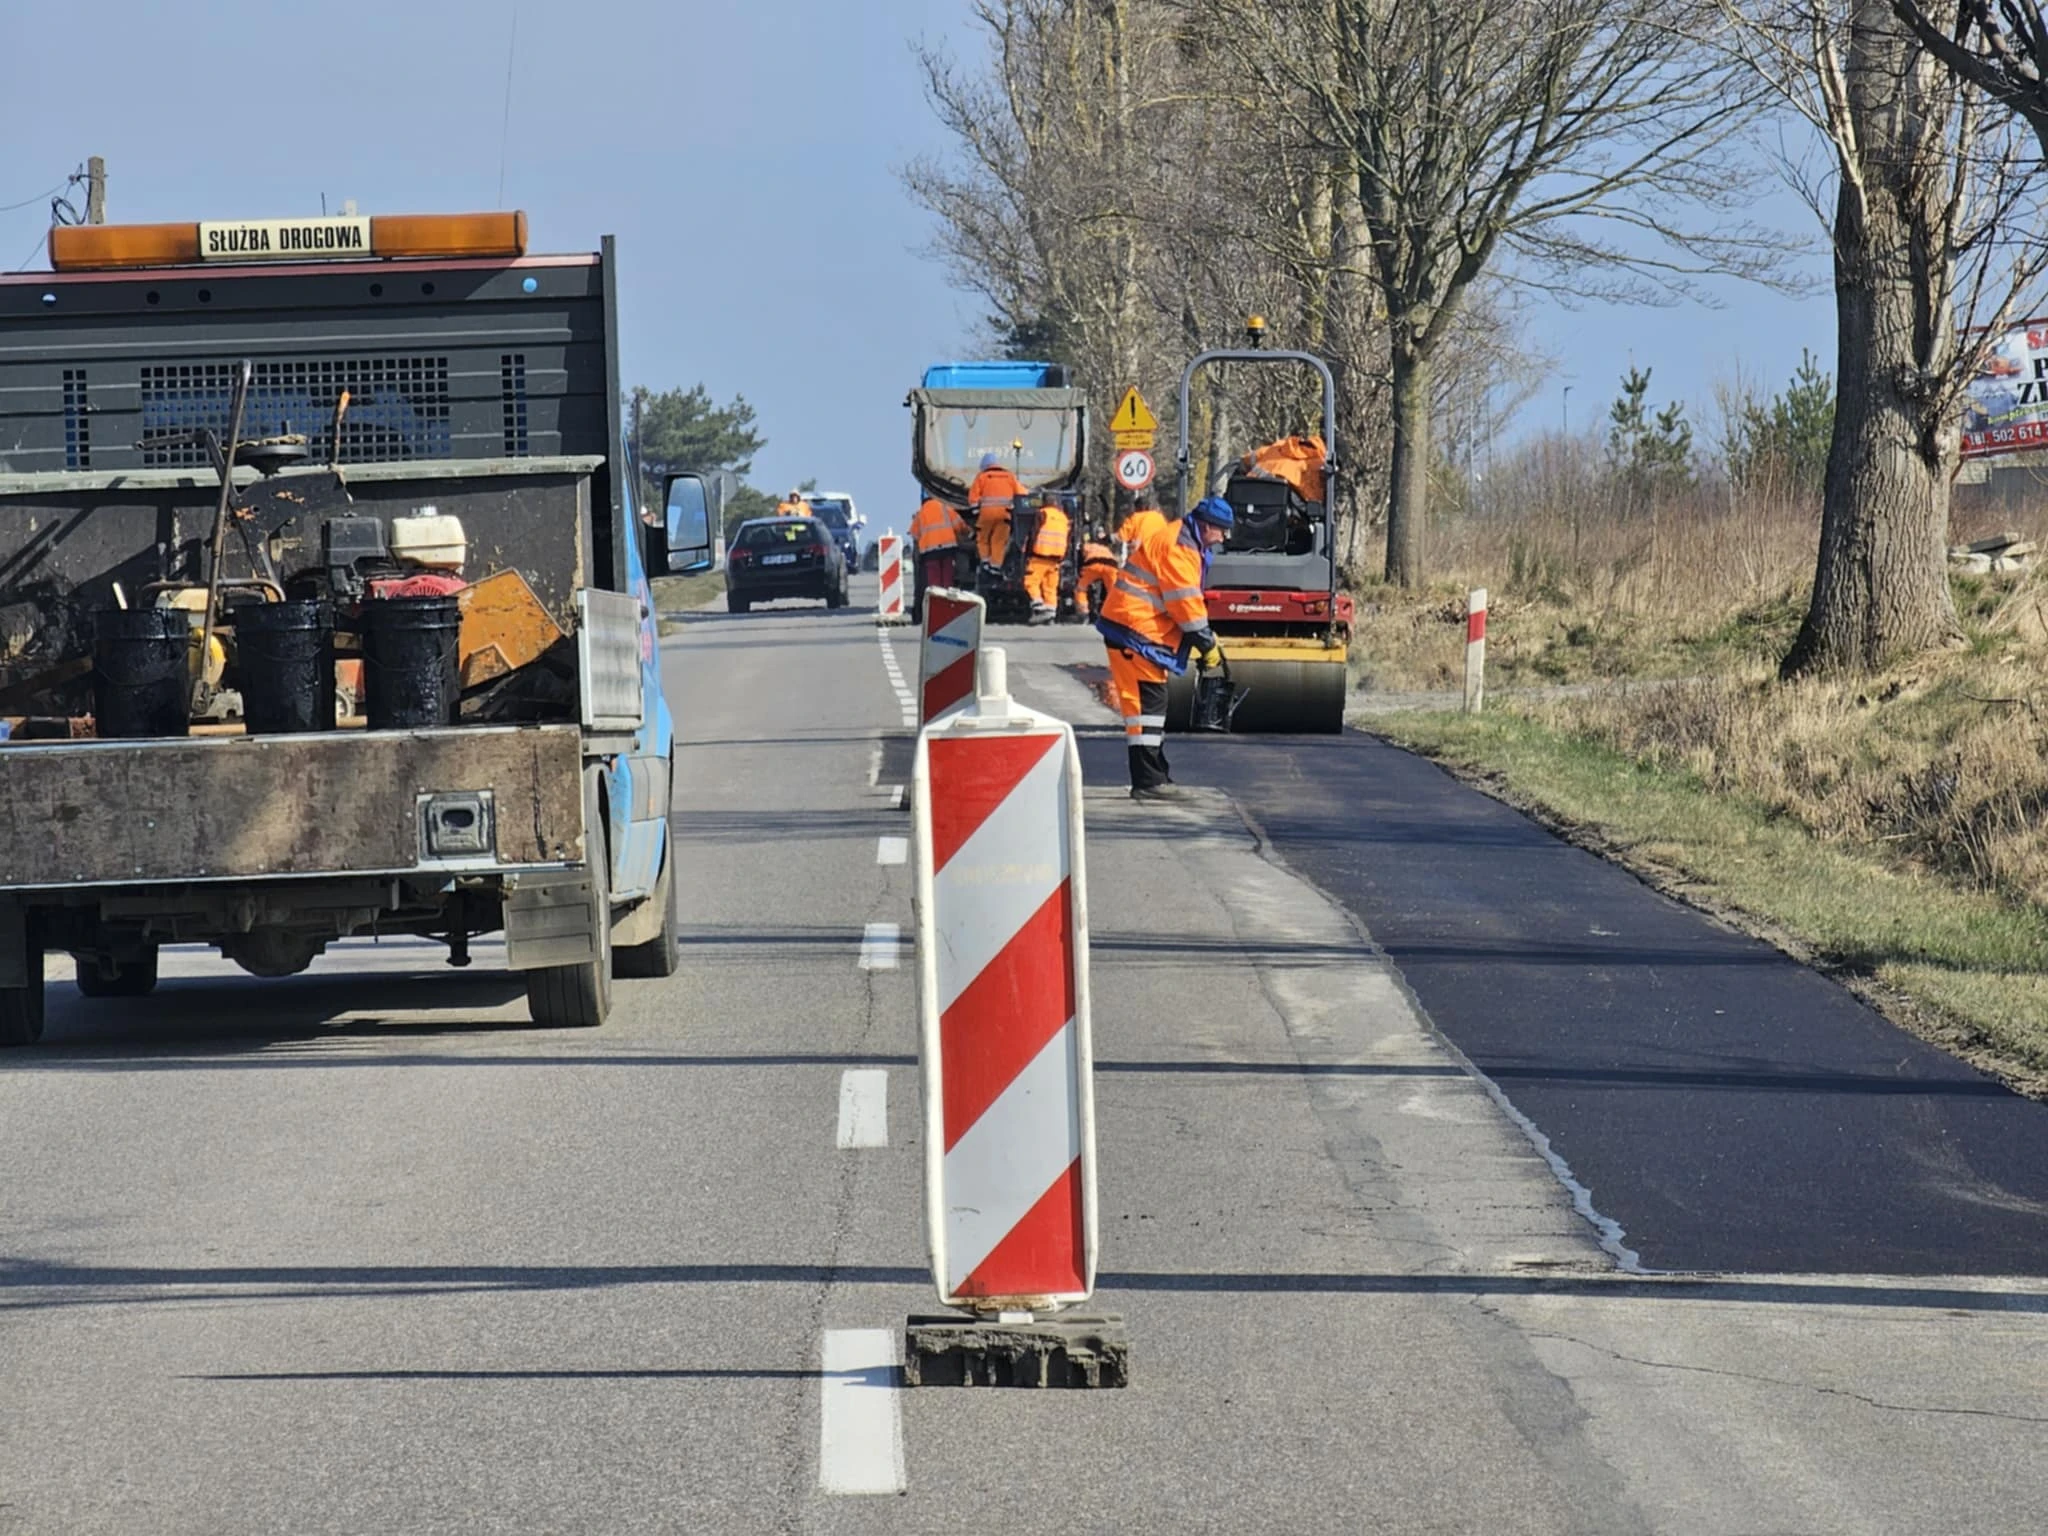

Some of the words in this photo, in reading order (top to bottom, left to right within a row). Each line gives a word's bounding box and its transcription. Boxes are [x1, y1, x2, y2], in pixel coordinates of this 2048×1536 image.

[209, 225, 271, 252] SŁUŻBA
[279, 226, 362, 250] DROGOWA
[1992, 428, 2017, 443] 502
[2019, 423, 2042, 440] 614
[1123, 459, 1147, 477] 60
